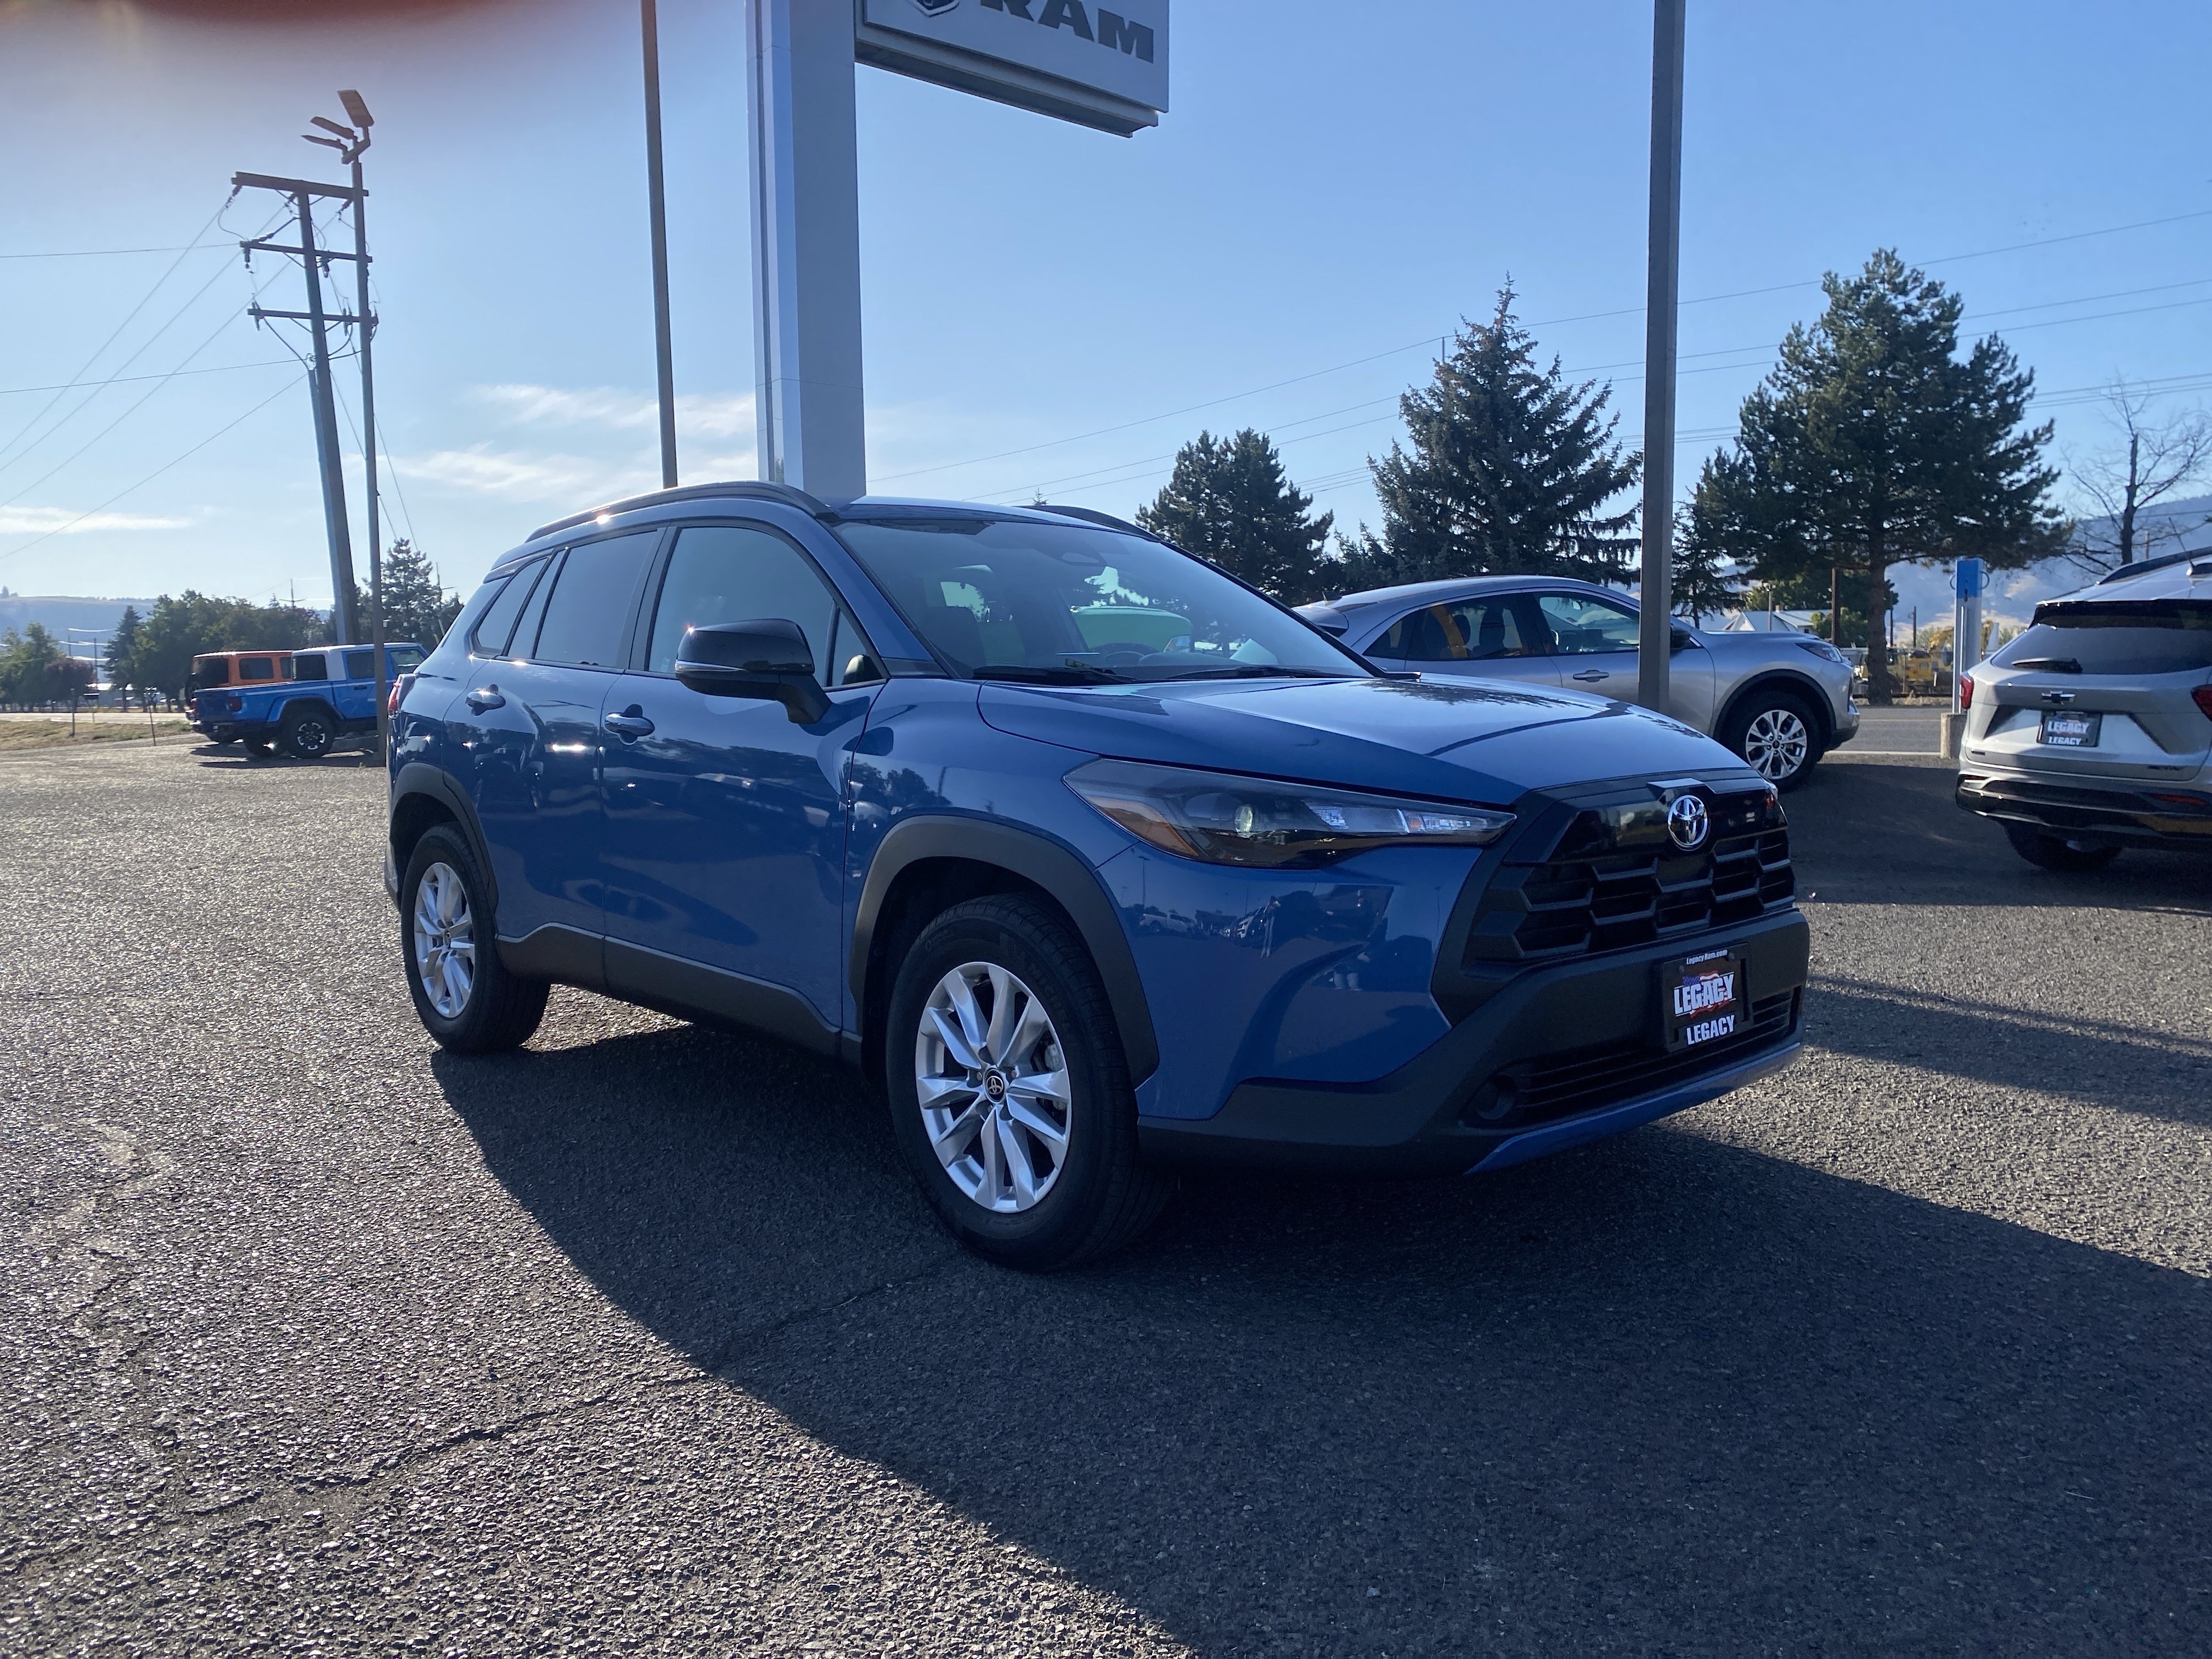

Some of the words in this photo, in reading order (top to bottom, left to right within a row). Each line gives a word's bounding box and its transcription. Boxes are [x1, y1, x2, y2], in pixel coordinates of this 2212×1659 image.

[2047, 720, 2089, 734] LEGACY
[2049, 736, 2081, 745] LEGACY
[1674, 974, 1734, 1014] LEGACY
[1687, 1015, 1735, 1045] LEGACY
